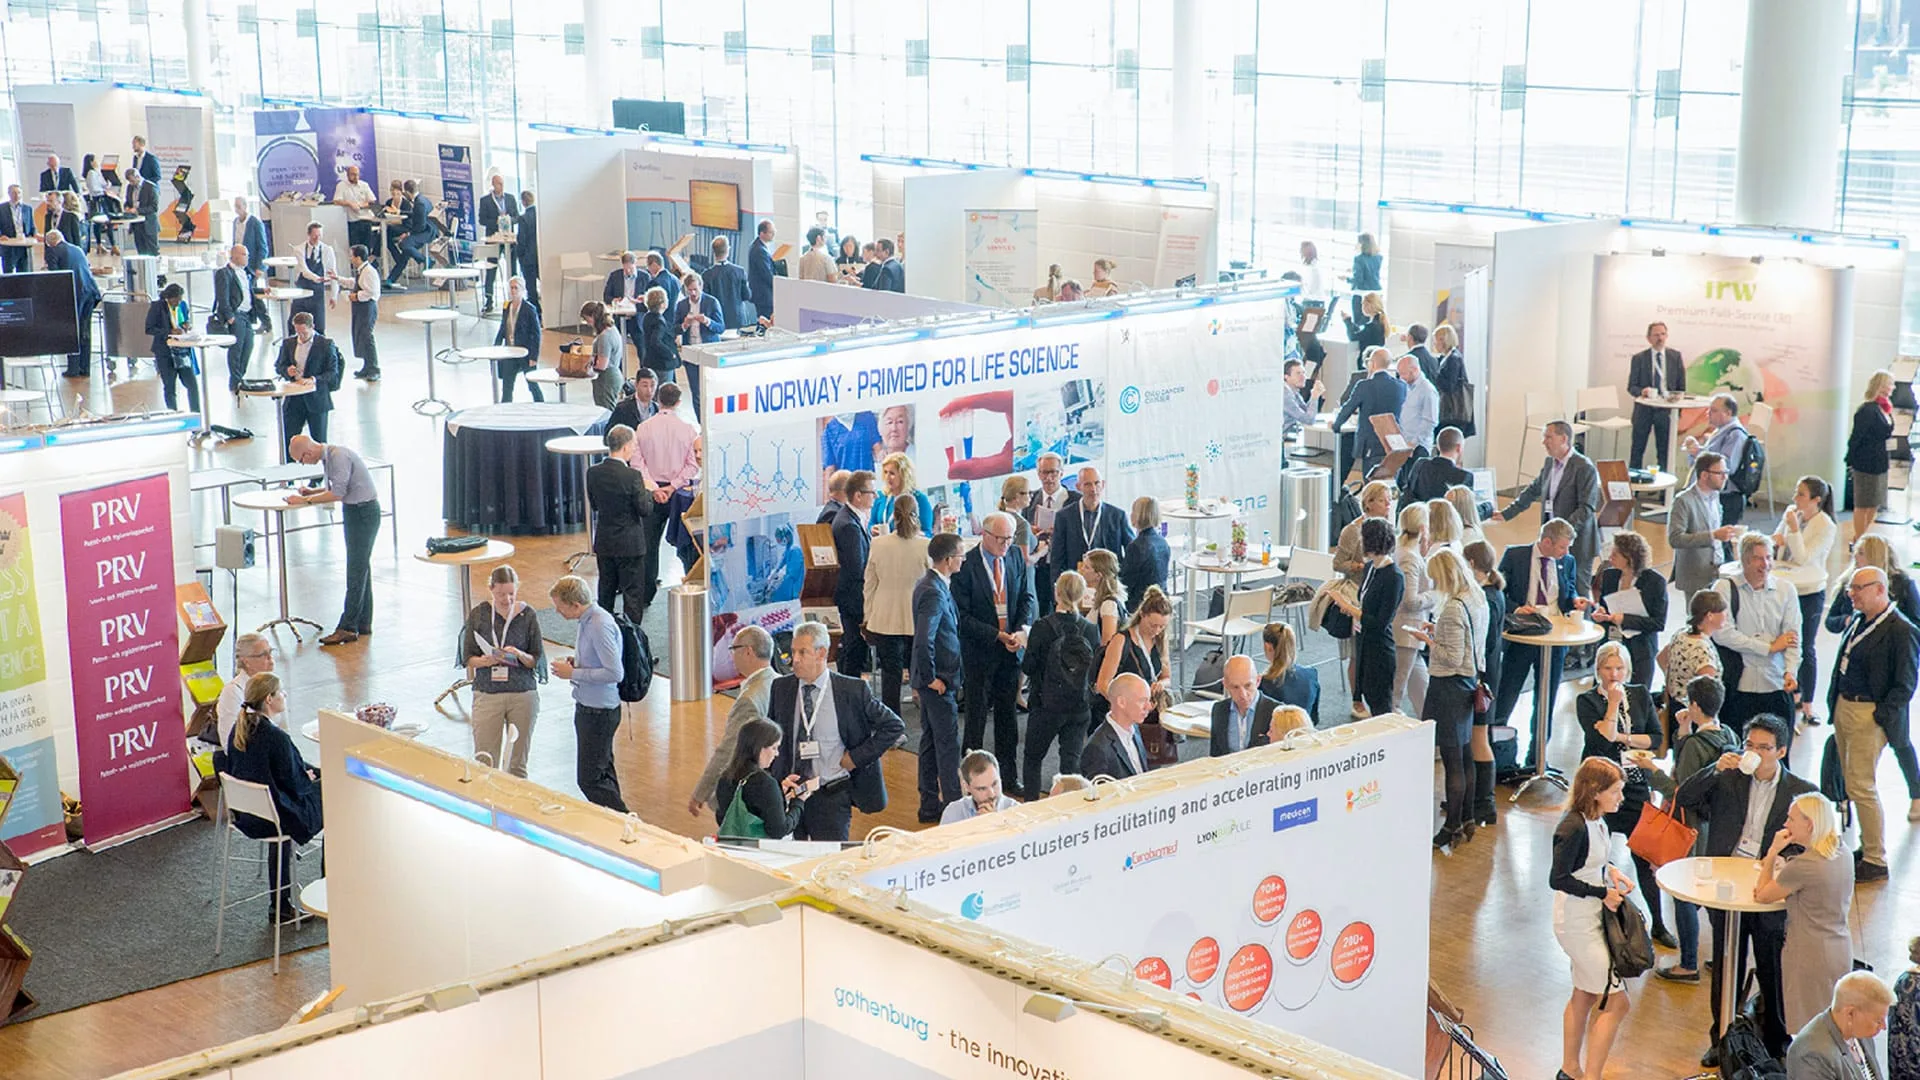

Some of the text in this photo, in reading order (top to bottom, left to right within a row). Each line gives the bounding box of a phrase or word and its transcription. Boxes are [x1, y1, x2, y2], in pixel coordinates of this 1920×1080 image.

[754, 374, 842, 414] NORWAY
[857, 363, 927, 400] PRIMED
[932, 357, 966, 387] FOR
[970, 353, 1005, 382] LIFE
[1008, 343, 1079, 378] SCIENCE
[91, 493, 141, 530] PRV
[96, 550, 146, 589] PRV
[100, 609, 149, 647] PRV
[104, 665, 153, 703] PRV
[108, 721, 158, 761] PRV
[903, 871, 936, 891] Life
[940, 850, 1016, 883] Sciences
[1020, 829, 1089, 860] Clusters
[1093, 805, 1177, 841] facilitating
[1181, 795, 1208, 817] and
[1212, 770, 1301, 809] accelerating
[1305, 748, 1385, 782] innovations
[833, 986, 929, 1041] gothenburg
[950, 1029, 981, 1058] the
